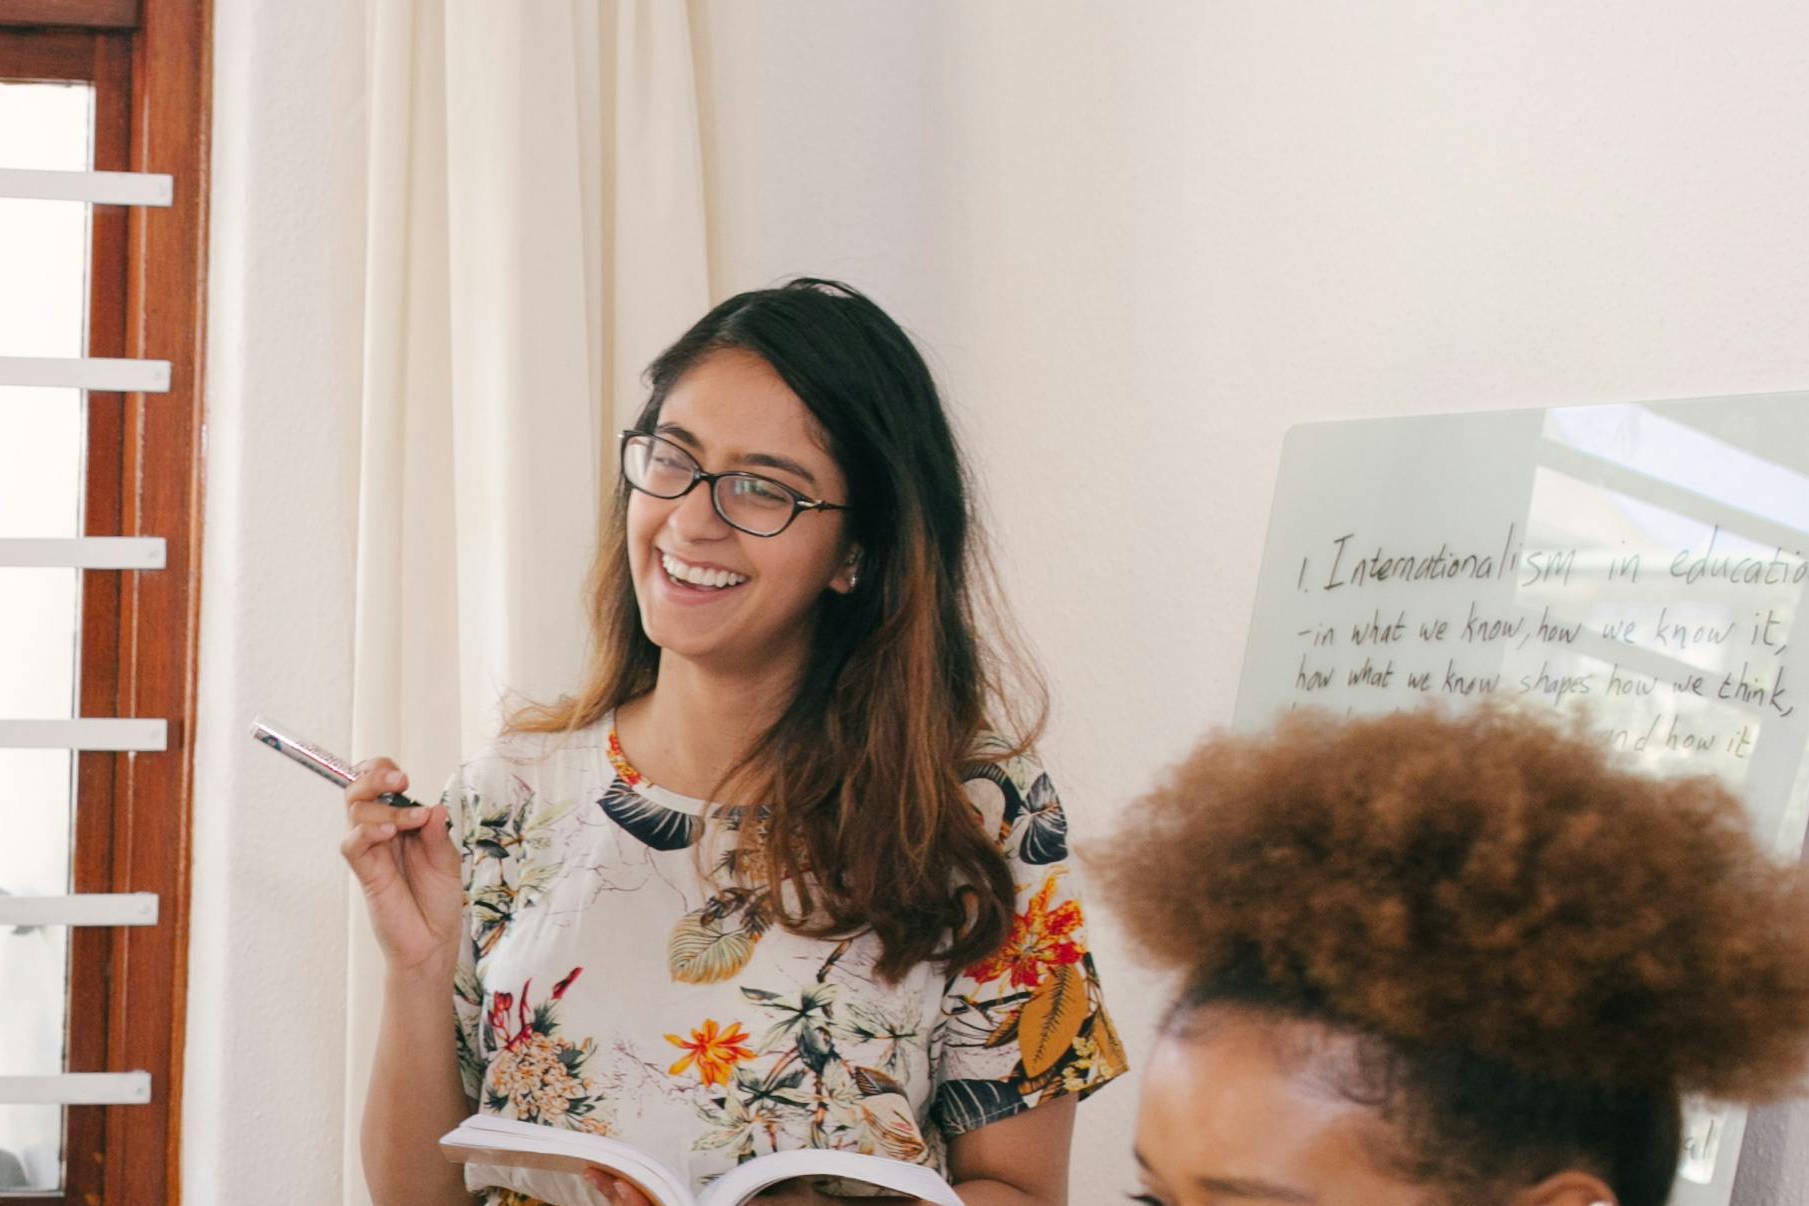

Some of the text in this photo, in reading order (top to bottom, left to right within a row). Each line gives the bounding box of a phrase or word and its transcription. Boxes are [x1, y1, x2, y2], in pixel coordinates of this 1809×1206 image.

[1323, 522, 1577, 590] Internationalism
[1608, 540, 1640, 583] in
[1351, 608, 1406, 645] what
[1419, 620, 1449, 641] we
[1461, 601, 1531, 650] know,
[1537, 606, 1582, 645] how
[1602, 620, 1636, 644] we
[1654, 607, 1736, 649] know
[1750, 609, 1788, 655] it,
[1295, 653, 1794, 717] how what we know shapes how we think,
[1665, 714, 1715, 750] how
[1726, 726, 1752, 759] it
